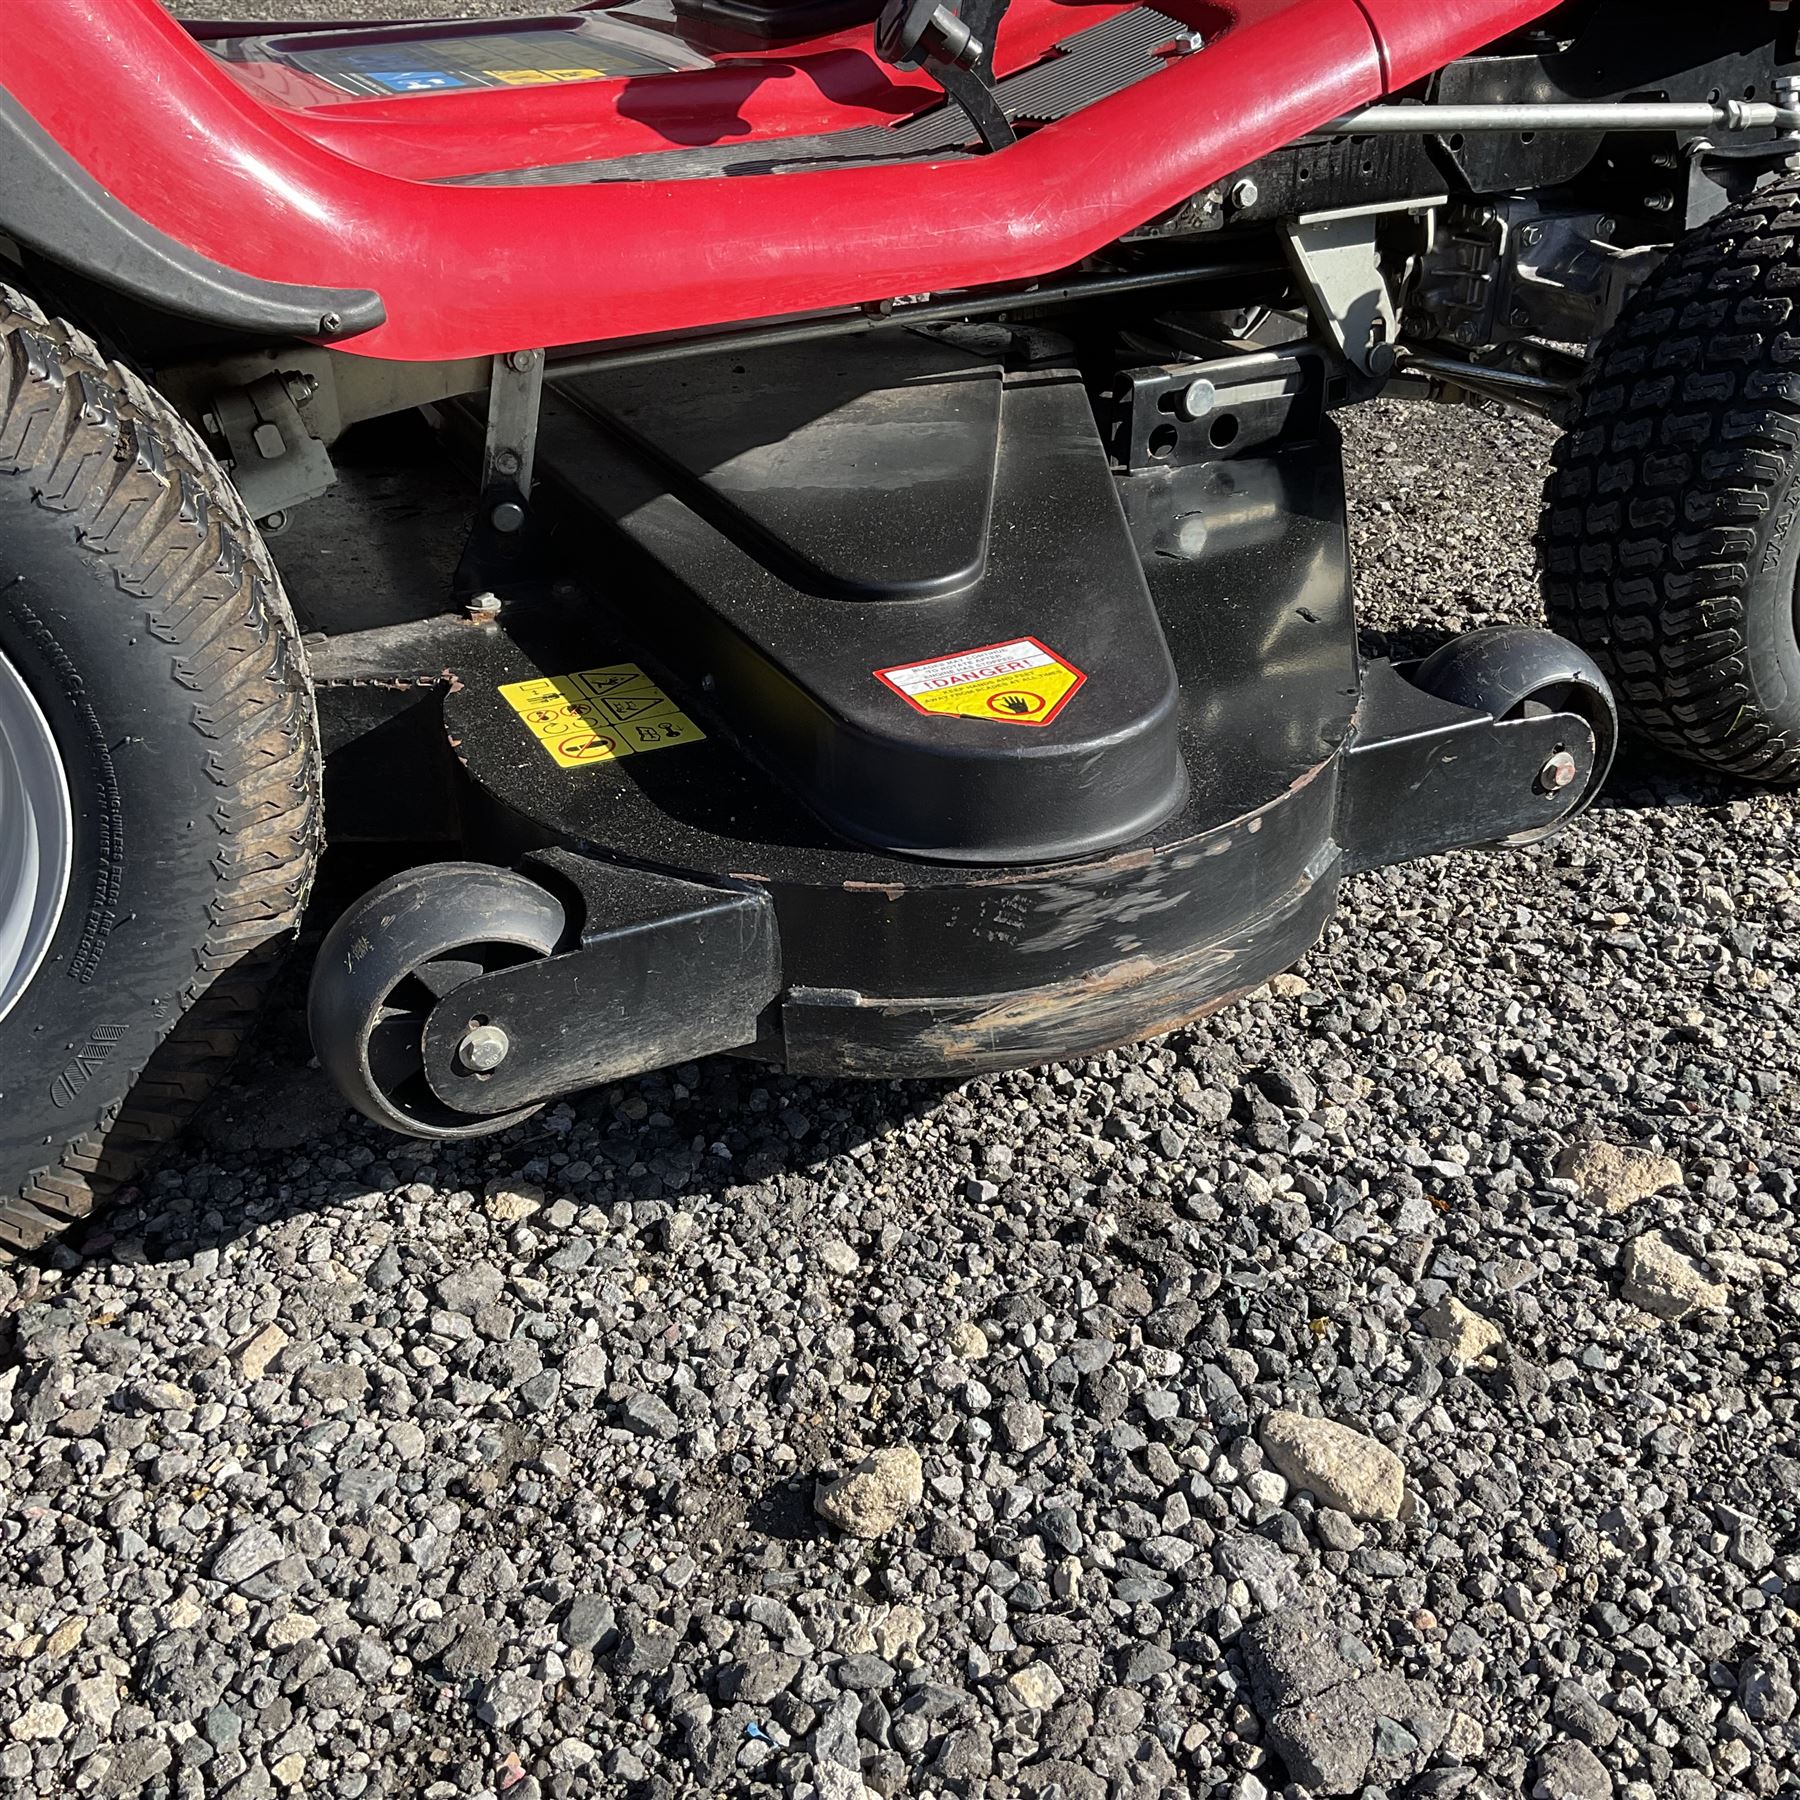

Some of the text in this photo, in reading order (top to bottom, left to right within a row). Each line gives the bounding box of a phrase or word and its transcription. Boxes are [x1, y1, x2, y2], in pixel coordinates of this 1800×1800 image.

[911, 662, 945, 673] BLADES
[924, 670, 954, 679] ENGINE
[976, 656, 1014, 668] STOPPED
[940, 661, 974, 671] ROTATE
[975, 654, 1002, 663] AFTER
[923, 660, 1032, 690] !DANGER!
[924, 695, 948, 703] AWAY
[949, 690, 975, 698] FROM
[975, 682, 1009, 692] BLADES
[1038, 669, 1063, 678] TIMES
[942, 671, 1035, 694] KEEP HANDS AND FEET
